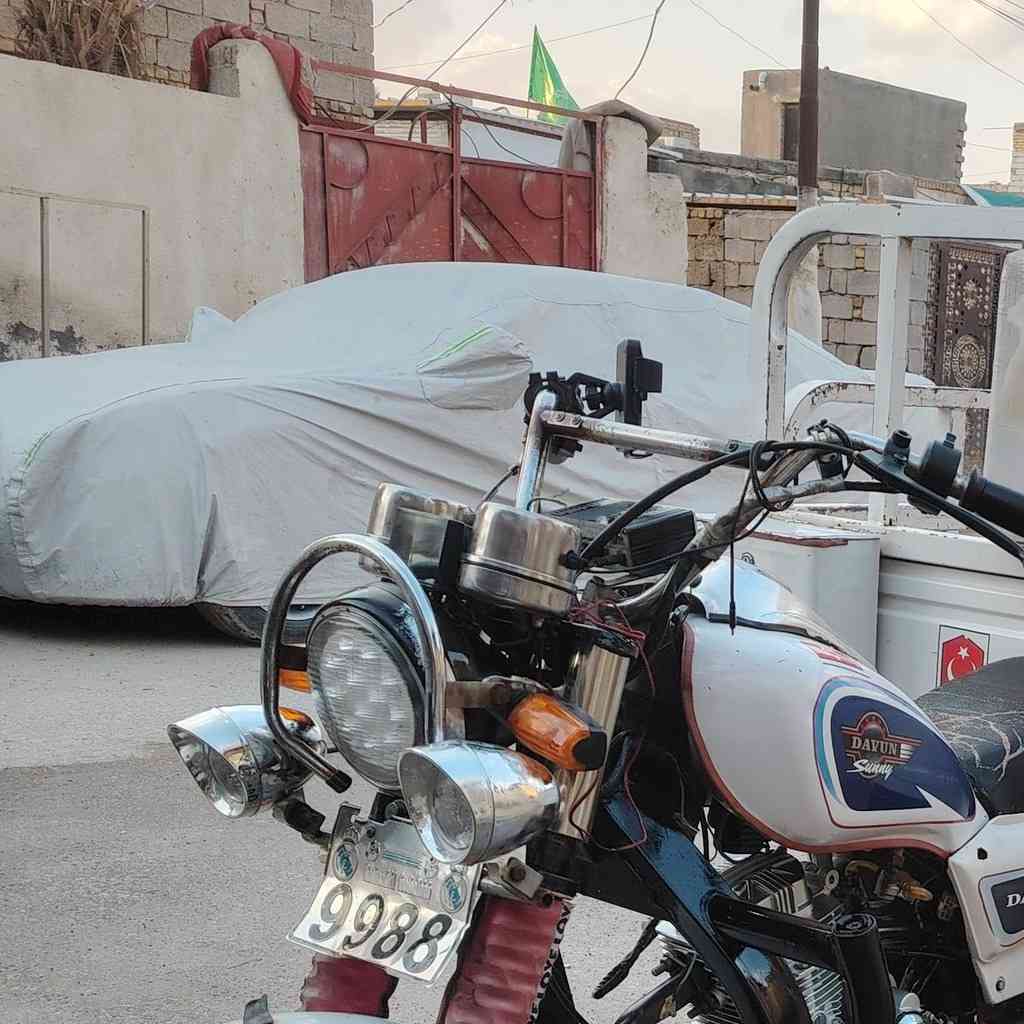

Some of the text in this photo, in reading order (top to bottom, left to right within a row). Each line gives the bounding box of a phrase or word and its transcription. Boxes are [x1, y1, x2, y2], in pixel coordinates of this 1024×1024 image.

[850, 736, 898, 756] DAYUN
[847, 759, 894, 781] Sunny
[308, 882, 452, 974] 9988
